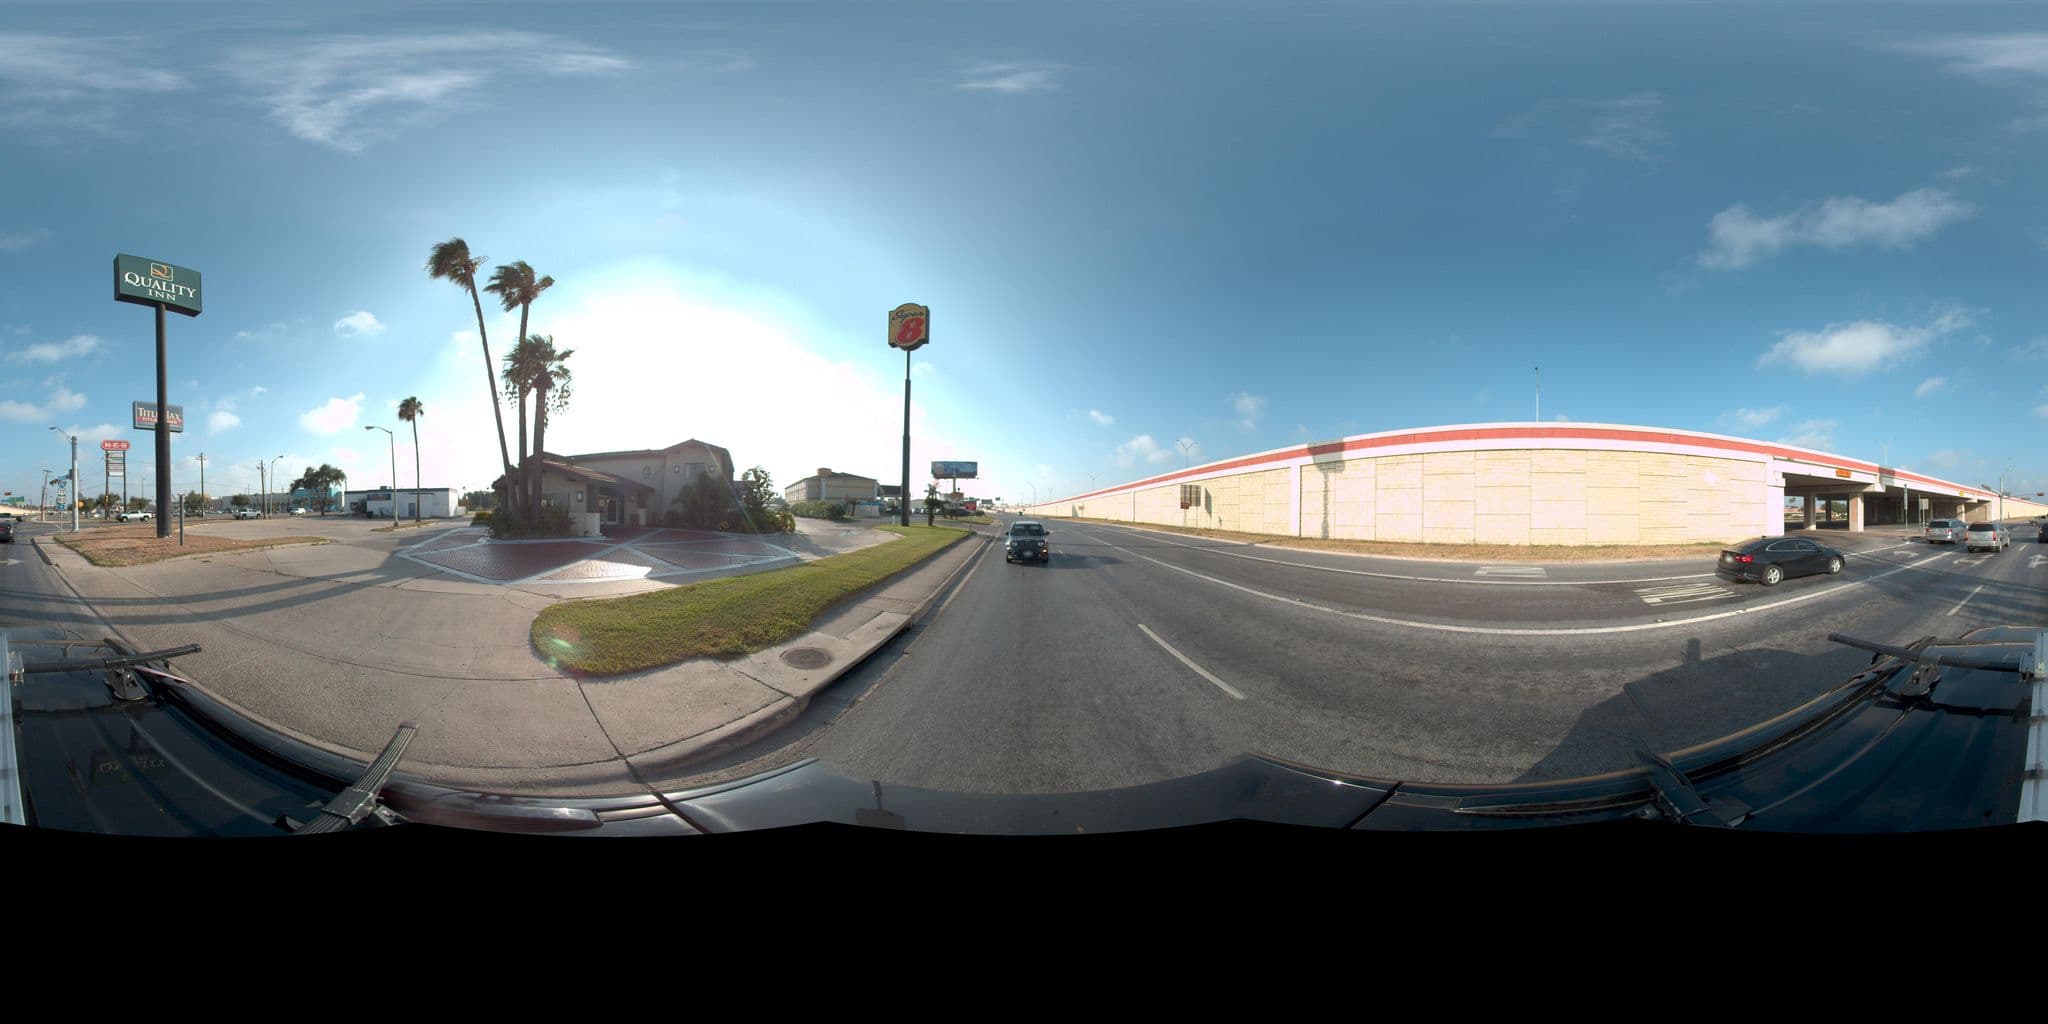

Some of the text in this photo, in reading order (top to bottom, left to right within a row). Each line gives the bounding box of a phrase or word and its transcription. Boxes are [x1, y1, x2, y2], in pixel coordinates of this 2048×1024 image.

[125, 272, 197, 298] QUALITY
[148, 289, 176, 301] INN
[895, 315, 925, 345] 8
